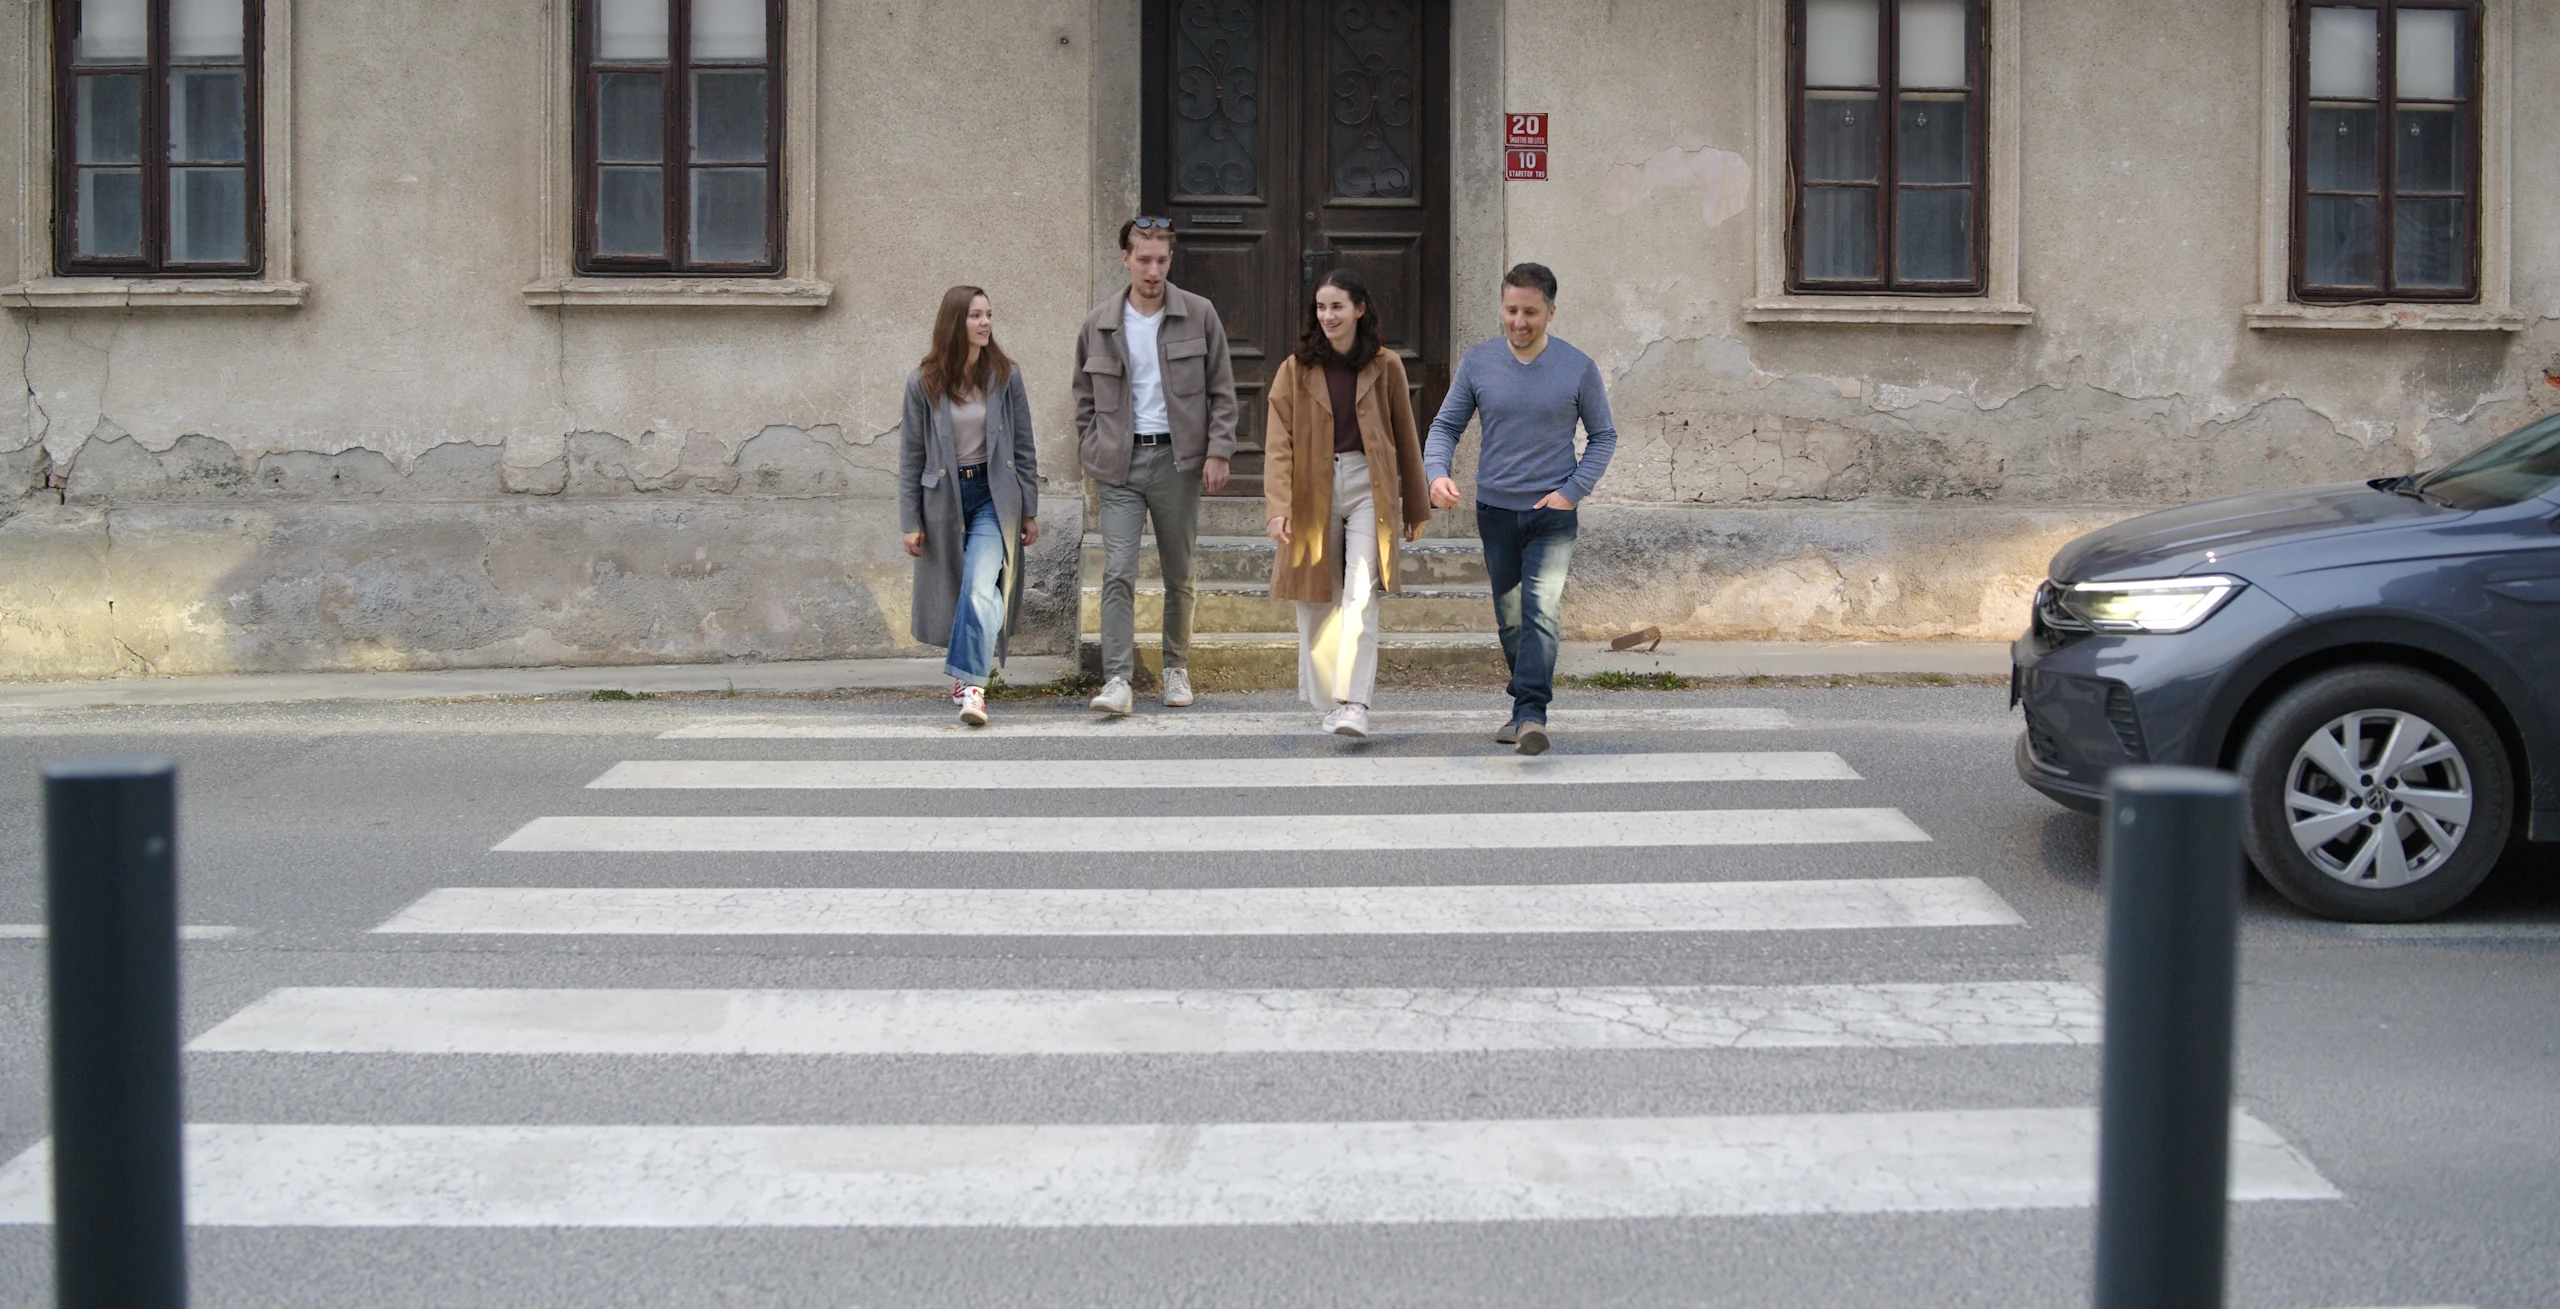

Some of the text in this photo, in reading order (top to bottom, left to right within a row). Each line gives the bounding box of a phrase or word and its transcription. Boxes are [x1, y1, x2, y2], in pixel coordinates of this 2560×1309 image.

[1513, 115, 1539, 135] 20
[1519, 152, 1536, 169] 10
[1535, 170, 1545, 178] TRG
